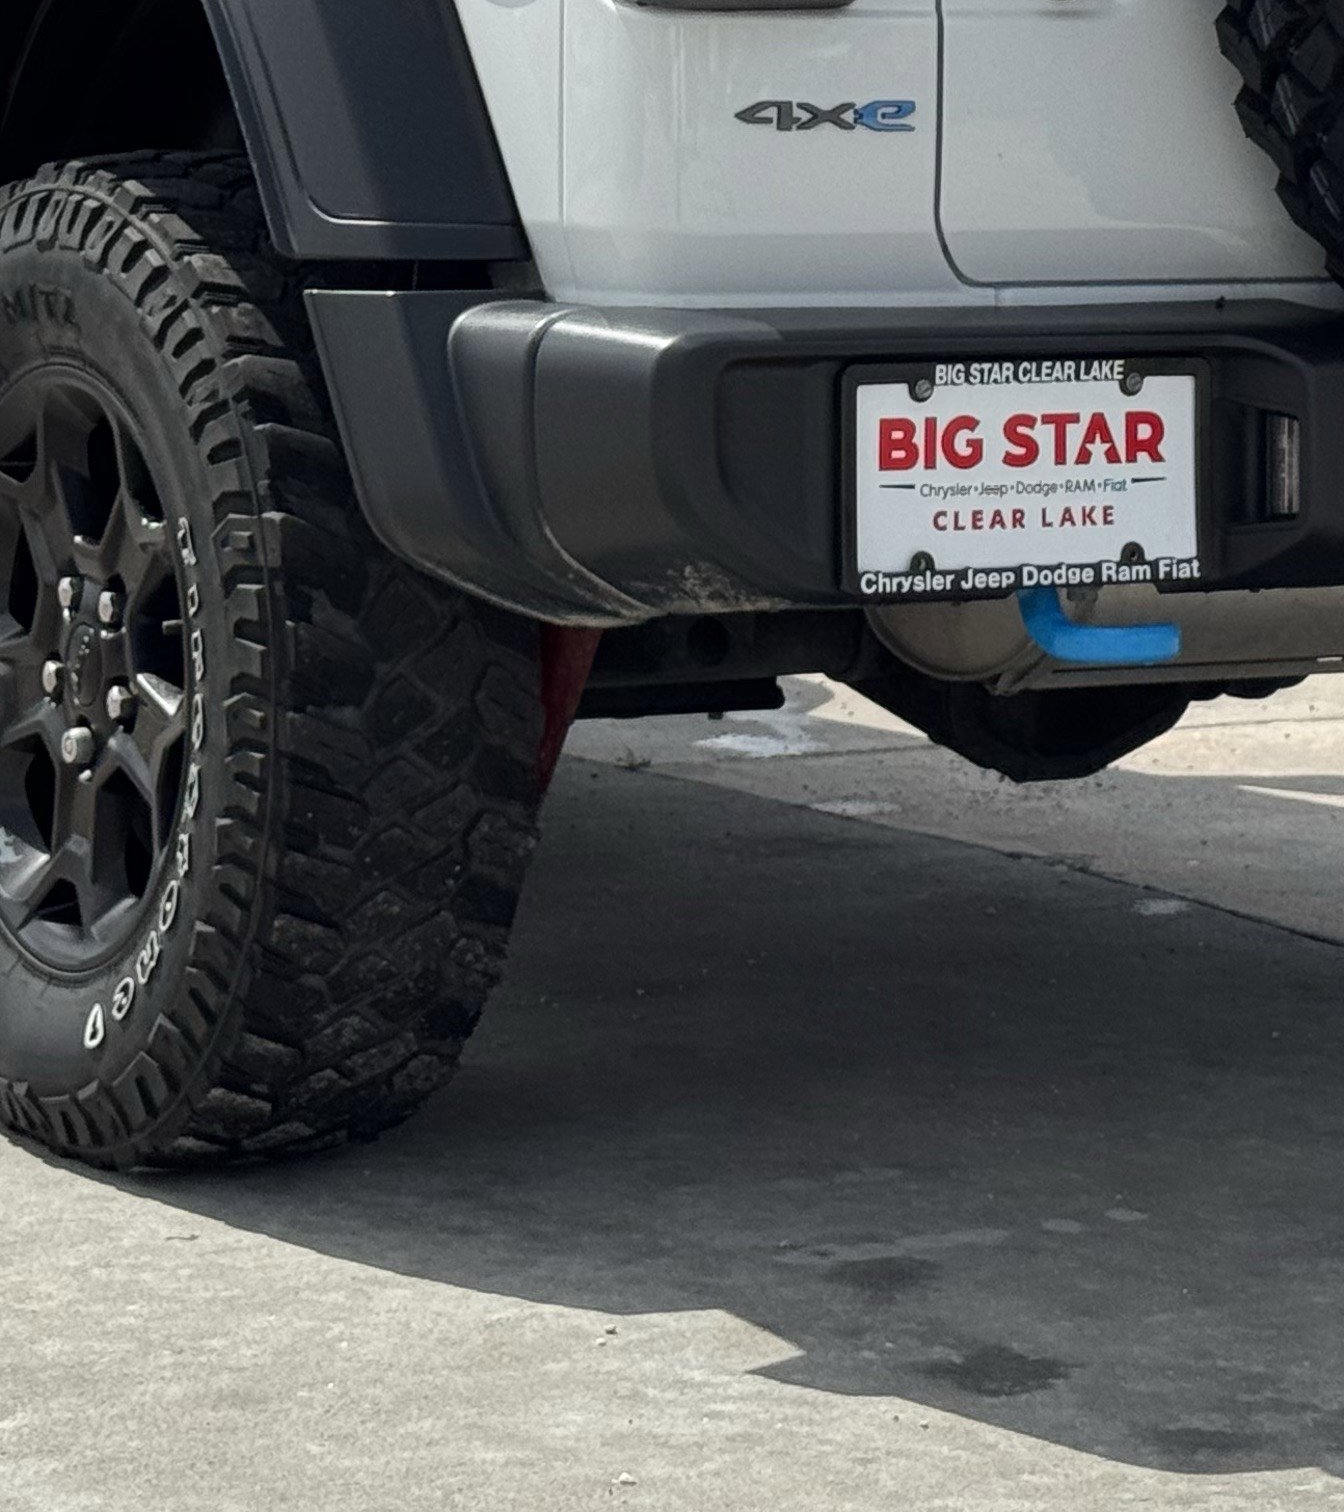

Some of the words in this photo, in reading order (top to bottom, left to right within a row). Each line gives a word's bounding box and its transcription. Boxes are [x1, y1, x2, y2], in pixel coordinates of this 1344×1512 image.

[934, 363, 966, 385] BIG
[969, 362, 1015, 385] STAR
[1018, 360, 1076, 383] CLEAR
[1079, 359, 1126, 381] LAKE
[878, 414, 984, 471] BIG
[1001, 410, 1166, 468] STAR
[1065, 478, 1096, 494] RAM
[932, 507, 1026, 532] CLEAR
[1041, 504, 1116, 529] LAKE
[860, 569, 956, 595] Chrysler
[960, 568, 1016, 590] Jeep
[1022, 563, 1095, 587] Dodge
[1101, 561, 1152, 583] Ram
[1158, 558, 1202, 580] Fiat
